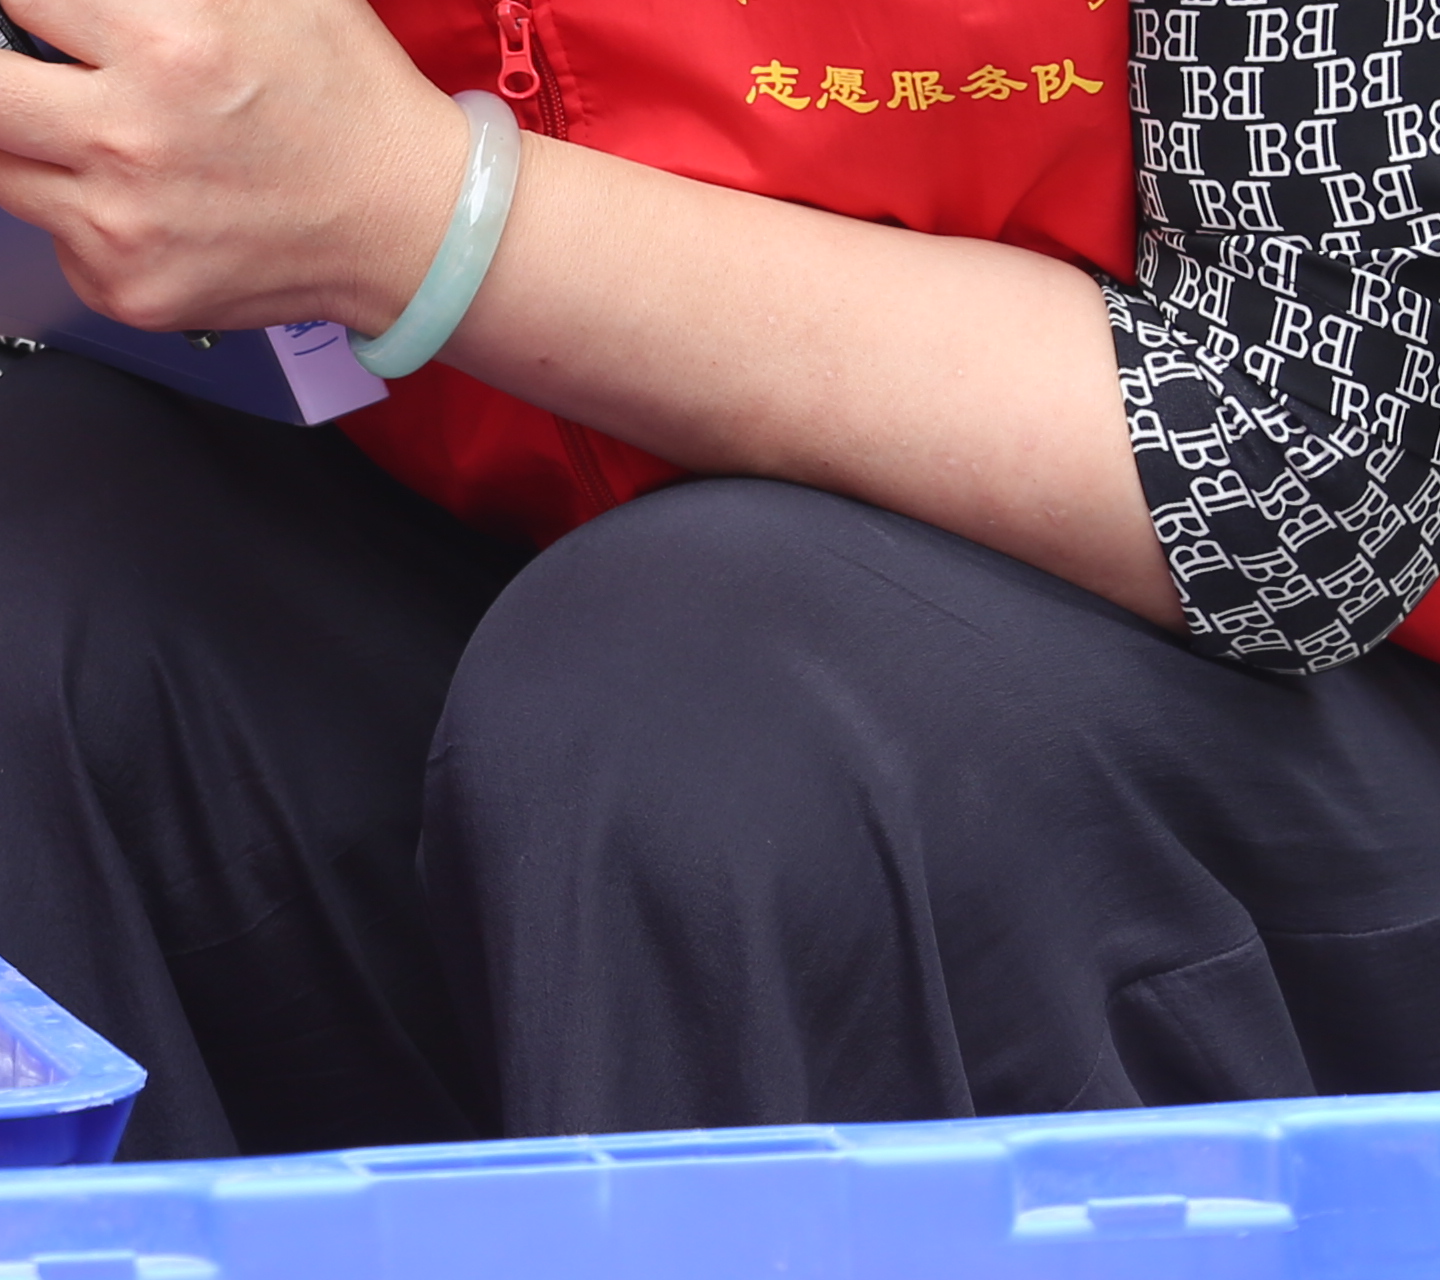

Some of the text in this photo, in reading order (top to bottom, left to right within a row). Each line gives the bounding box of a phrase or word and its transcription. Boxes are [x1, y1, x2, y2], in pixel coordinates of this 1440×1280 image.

[745, 59, 1104, 114] 志愿服务队
